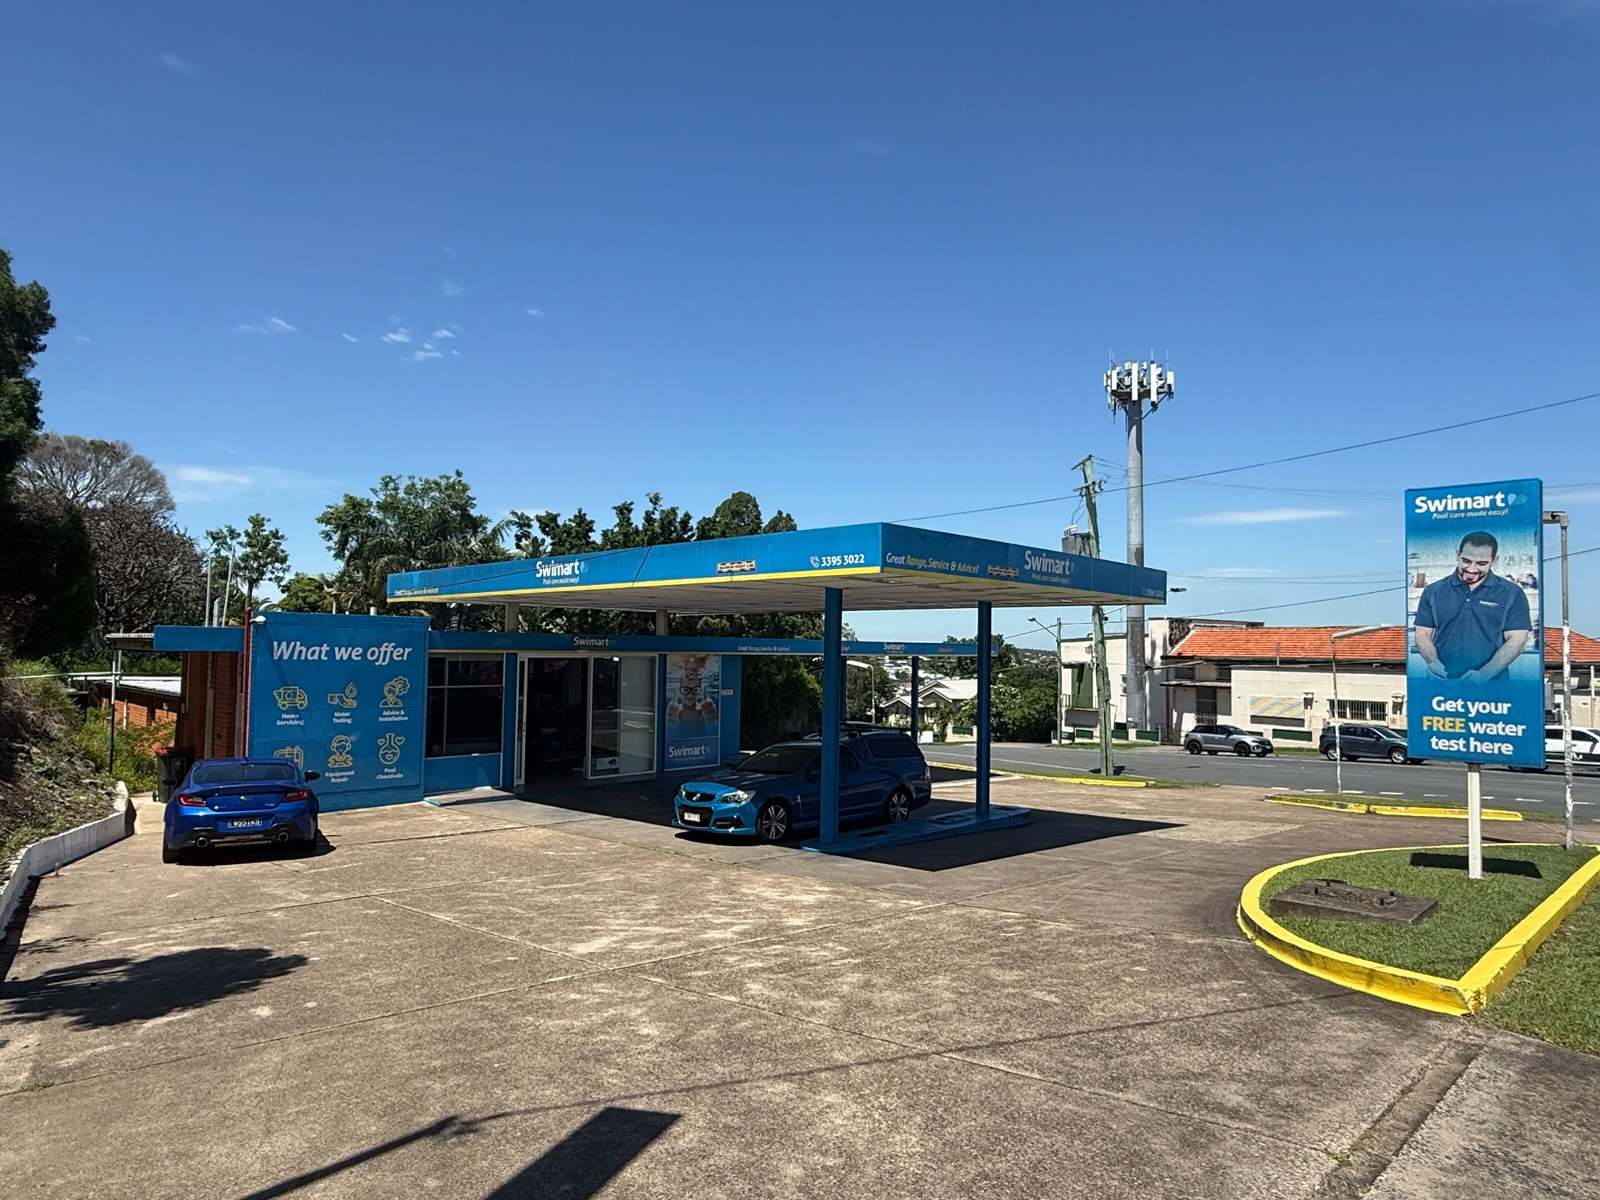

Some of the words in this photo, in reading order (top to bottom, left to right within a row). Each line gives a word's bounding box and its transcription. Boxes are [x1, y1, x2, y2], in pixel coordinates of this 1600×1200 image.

[1415, 491, 1505, 513] Swimart
[1432, 512, 1449, 520] Pool
[1488, 508, 1509, 517] easy!
[536, 559, 579, 577] Swimart
[821, 555, 842, 567] 3395
[843, 554, 865, 565] 3022
[886, 553, 906, 565] Great
[928, 558, 949, 570] Service
[1024, 549, 1070, 575] Swimart
[574, 636, 609, 646] Swimart
[273, 641, 329, 660] What
[334, 646, 363, 660] we
[367, 642, 412, 665] offer
[1431, 696, 1465, 713] Get
[1466, 701, 1512, 718] your
[1422, 716, 1466, 733] FREE
[1468, 721, 1526, 737] water
[668, 745, 706, 757] Swimart
[1430, 736, 1467, 752] test
[1469, 737, 1514, 755] here
[325, 770, 355, 778] Equipment
